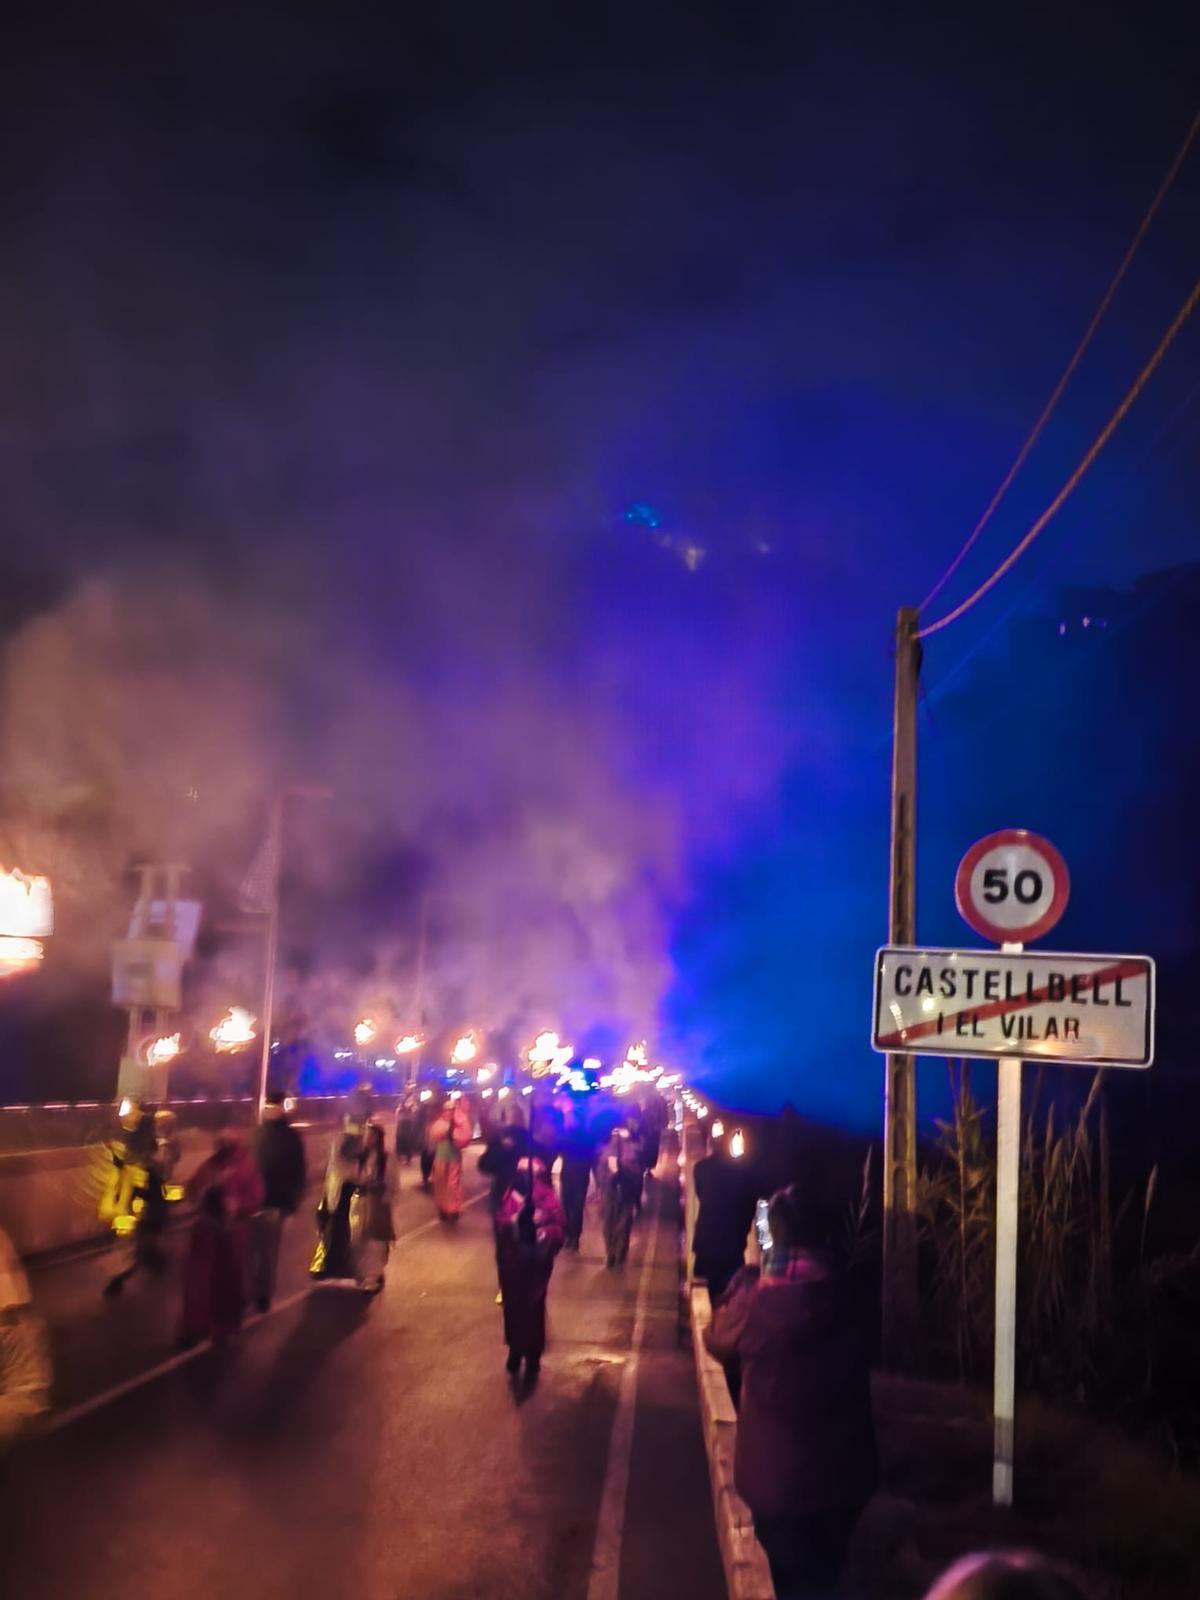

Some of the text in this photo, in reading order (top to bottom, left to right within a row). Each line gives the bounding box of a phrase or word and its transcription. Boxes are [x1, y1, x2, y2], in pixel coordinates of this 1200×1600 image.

[983, 869, 1043, 904] 50
[894, 966, 1132, 1007] CASTELLBELL
[956, 1013, 985, 1037] EL
[1001, 1014, 1081, 1040] VILAR
